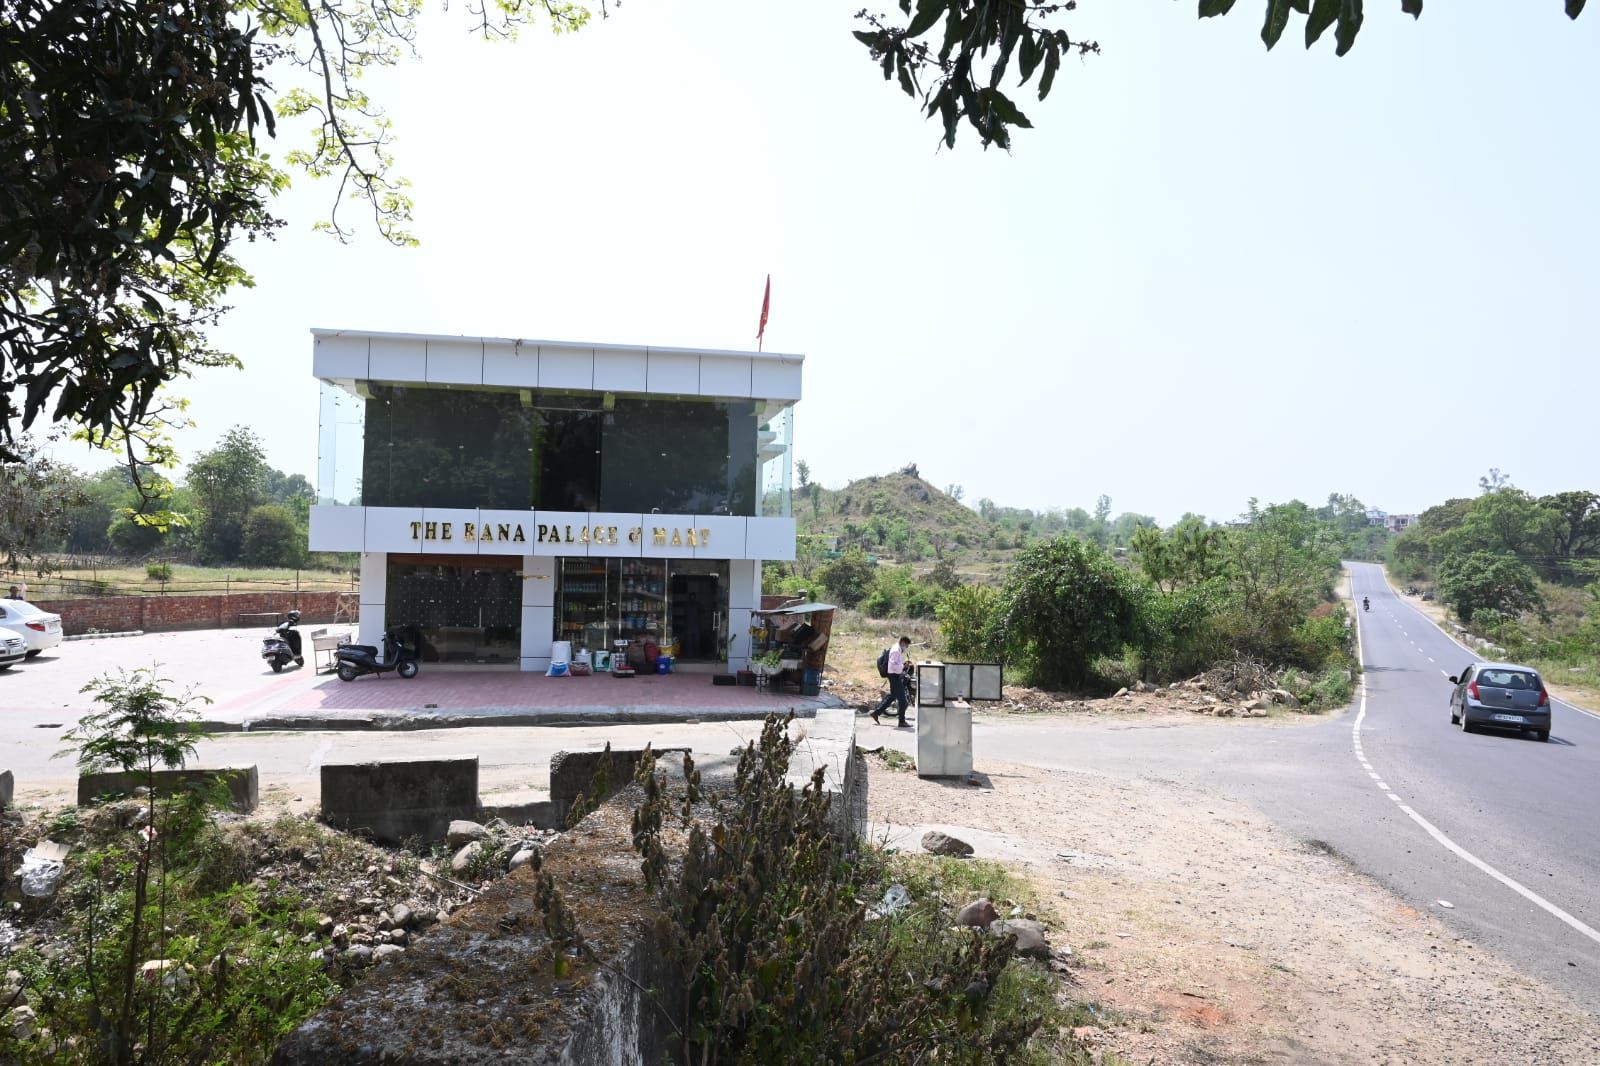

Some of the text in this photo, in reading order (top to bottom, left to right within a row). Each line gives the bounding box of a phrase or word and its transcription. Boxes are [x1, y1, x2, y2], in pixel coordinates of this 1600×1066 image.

[410, 521, 452, 540] THE
[464, 522, 526, 542] RANA
[537, 524, 618, 544] PALACE
[653, 526, 710, 546] MART
